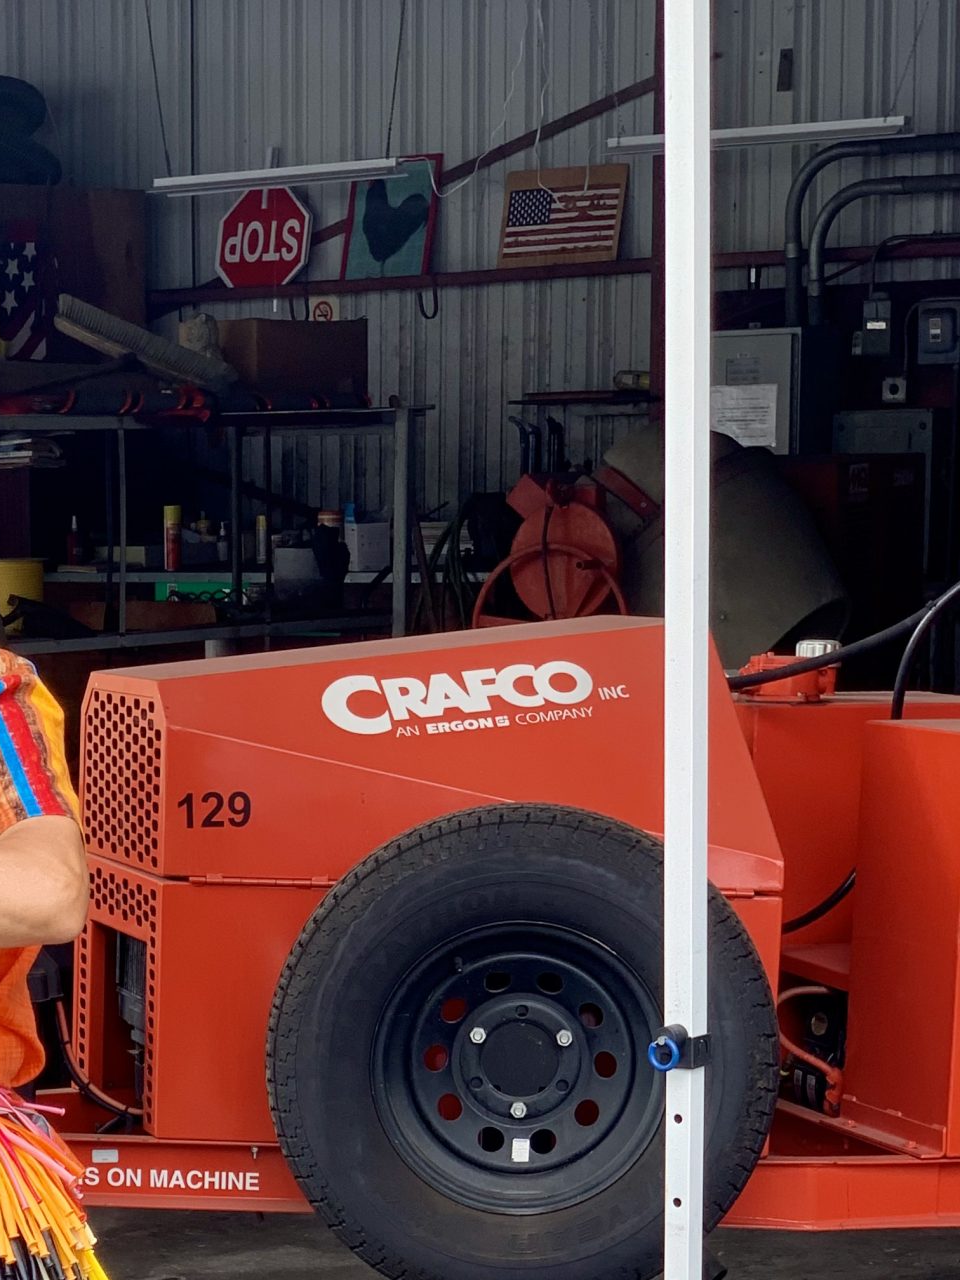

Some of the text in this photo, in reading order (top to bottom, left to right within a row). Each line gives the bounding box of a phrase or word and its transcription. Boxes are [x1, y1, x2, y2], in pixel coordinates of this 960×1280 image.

[224, 218, 301, 263] STOP
[321, 660, 630, 735] CRAFCO INC
[396, 706, 593, 738] AN ERGON COMPANY
[177, 791, 251, 829] 129
[107, 1167, 142, 1187] ON
[150, 1169, 260, 1191] MACHINE
